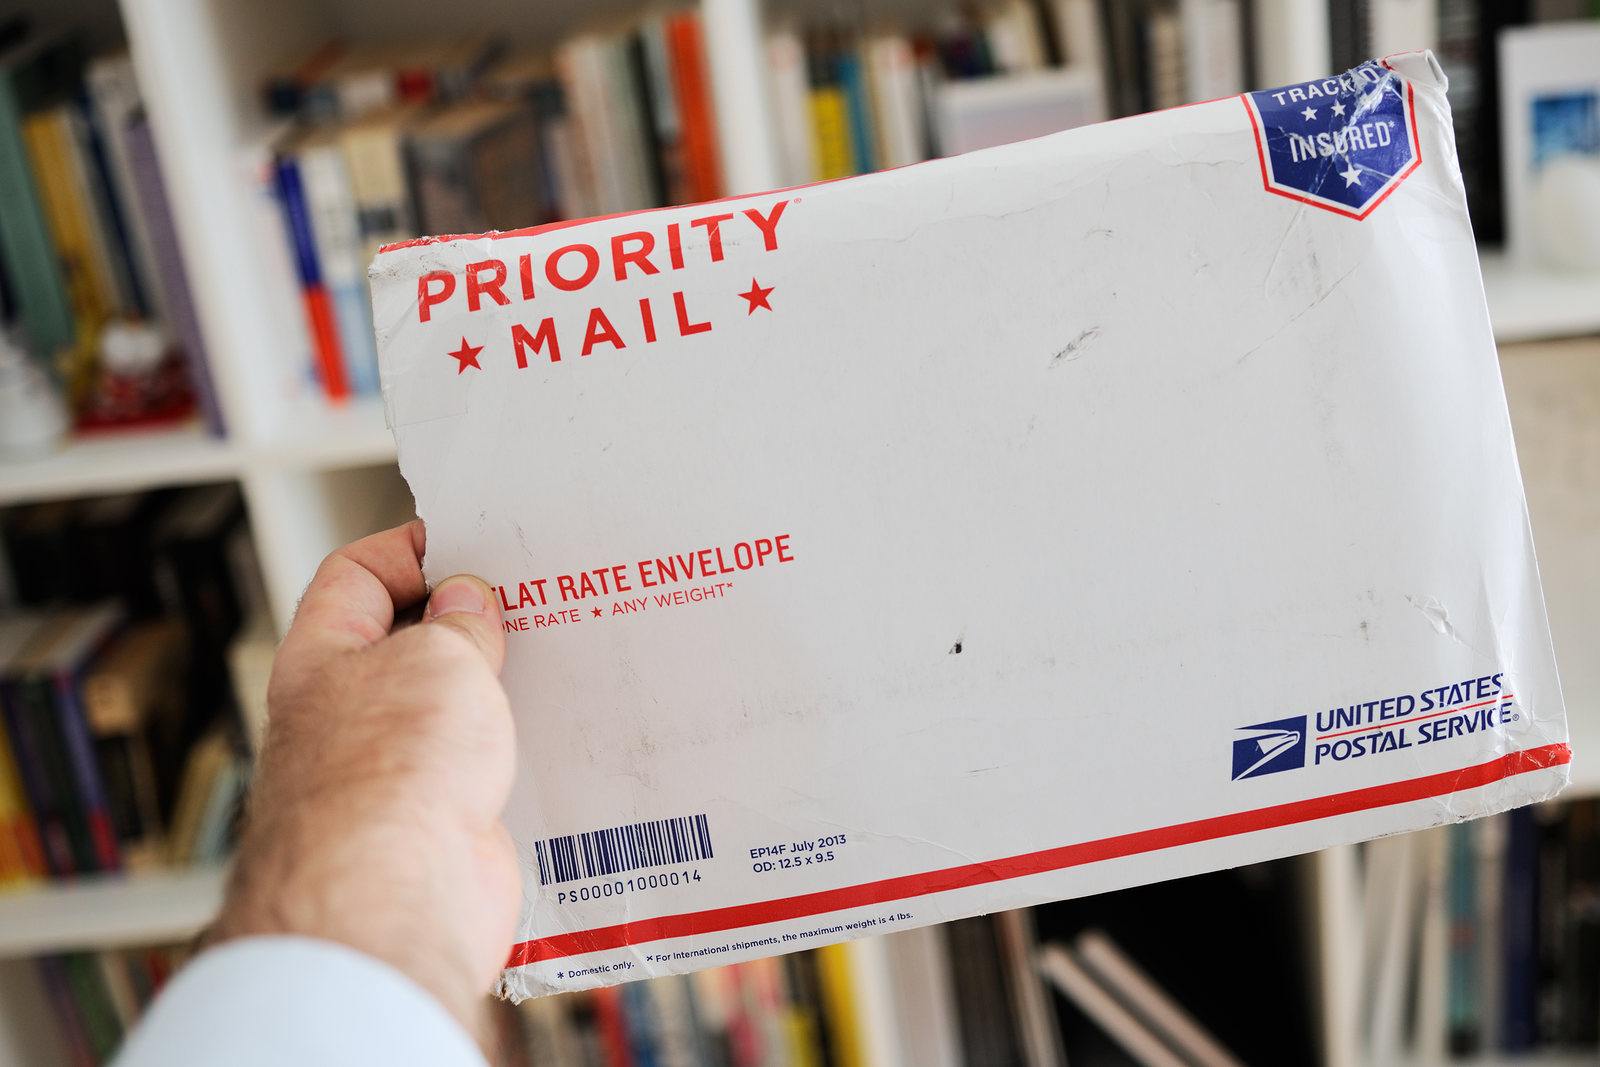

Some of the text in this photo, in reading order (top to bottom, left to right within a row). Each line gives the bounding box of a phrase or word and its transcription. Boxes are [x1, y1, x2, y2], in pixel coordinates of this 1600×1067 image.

[1272, 67, 1380, 105] TRACKD
[511, 291, 712, 369] MAIL
[491, 534, 794, 611] LAT RATE ENVELOPE
[502, 617, 530, 633] NE
[534, 609, 582, 629] RATE
[612, 597, 649, 616] ANY
[1316, 673, 1504, 732] UNITED STATES
[1315, 729, 1412, 765] POSTAL
[750, 834, 847, 859] EP14F July 2013
[753, 862, 777, 873] OD:
[778, 856, 802, 869] 12.5
[815, 851, 835, 863] 9.5
[655, 954, 671, 963] For
[673, 944, 730, 960] International
[731, 937, 781, 952] shipments,
[782, 933, 798, 942] the
[799, 925, 843, 938] maximum
[845, 918, 876, 930] weight
[878, 916, 887, 925] is
[888, 914, 895, 923] 4
[896, 911, 914, 921] lbs.
[568, 966, 611, 979] Domestic
[612, 960, 635, 971] only.
